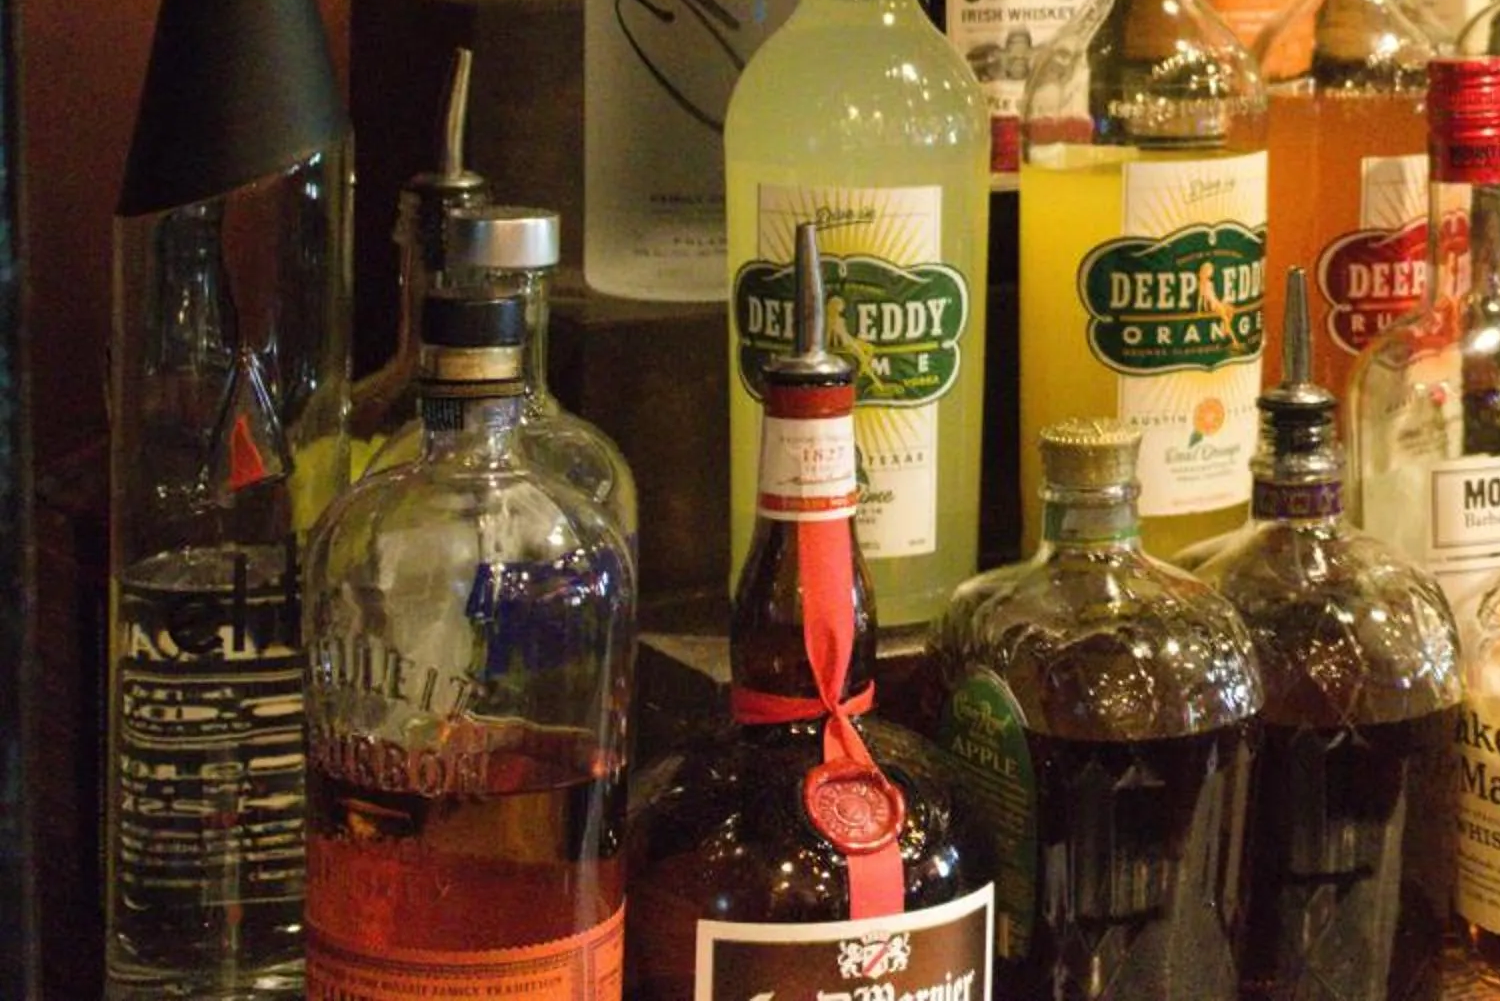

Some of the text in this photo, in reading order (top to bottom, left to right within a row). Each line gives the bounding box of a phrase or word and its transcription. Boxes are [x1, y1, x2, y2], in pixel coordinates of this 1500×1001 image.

[961, 8, 1003, 23] IRISH
[1109, 261, 1266, 310] DEEP EDD
[857, 298, 946, 340] EDDY
[1130, 414, 1188, 426] AUSTIN
[868, 451, 925, 466] TEXAS
[305, 634, 488, 724] ULLEIT
[951, 734, 1018, 776] APPLE
